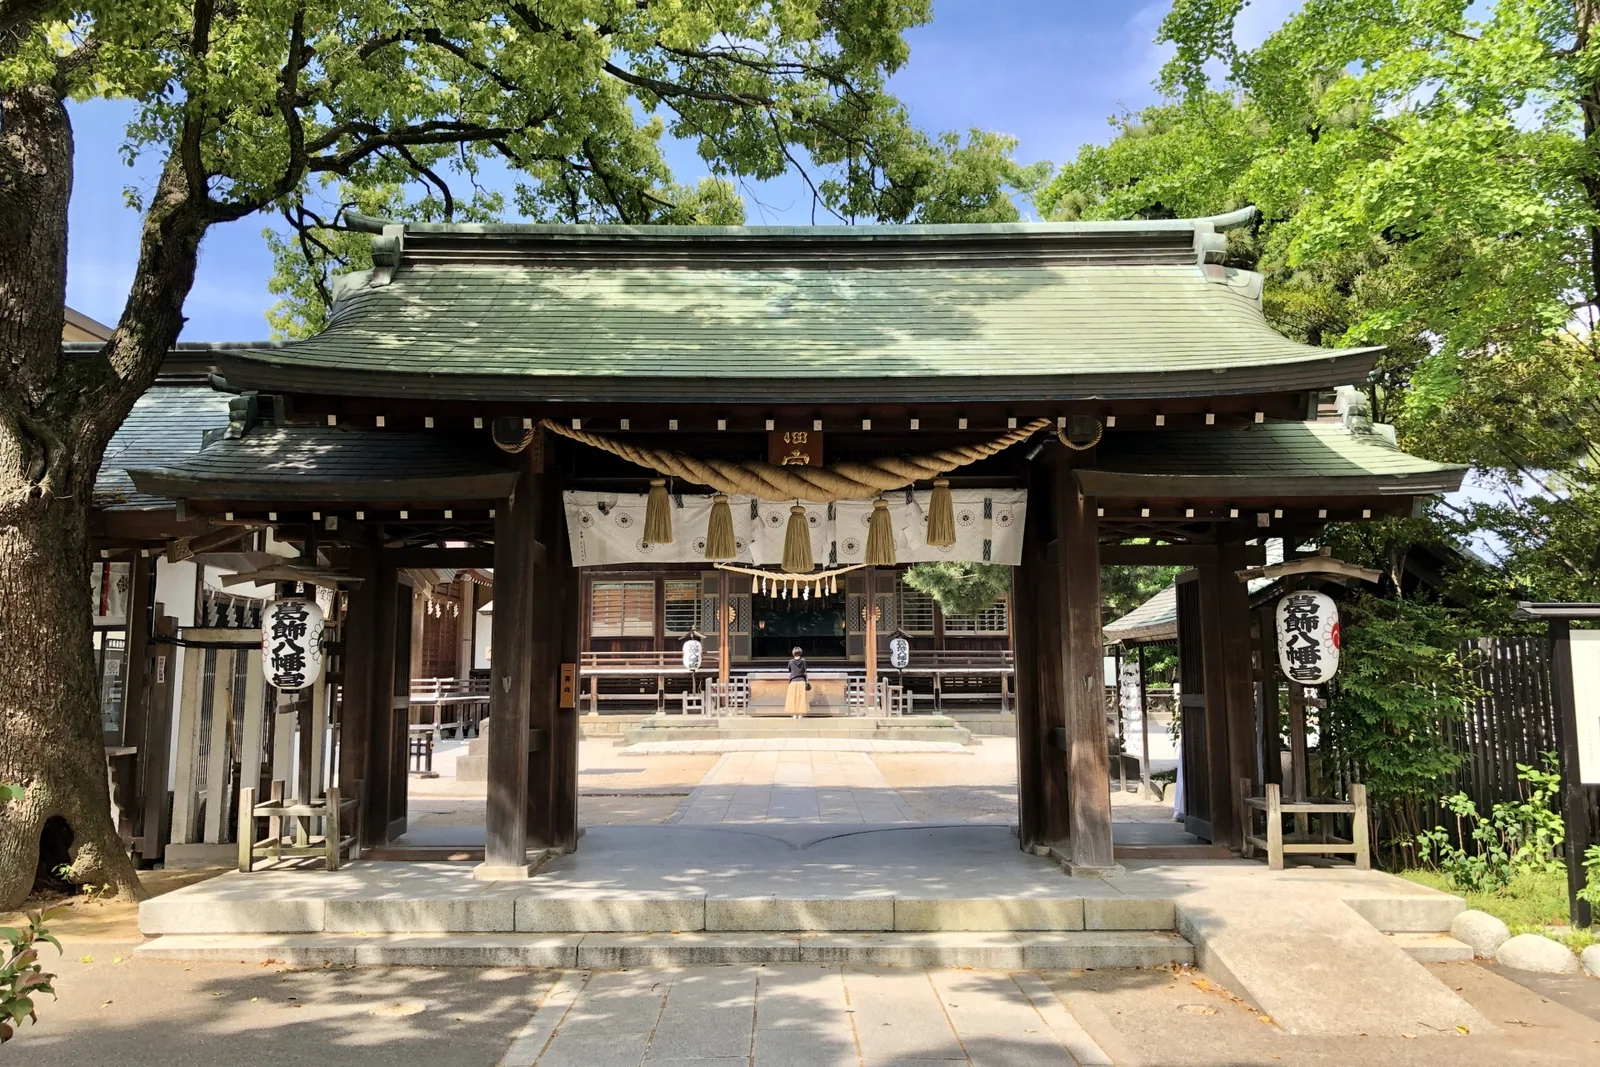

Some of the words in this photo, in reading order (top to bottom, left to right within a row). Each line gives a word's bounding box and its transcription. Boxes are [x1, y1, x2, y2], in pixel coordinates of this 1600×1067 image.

[270, 601, 310, 688] 葛飾八幡宮
[1283, 594, 1322, 681] 葛飾八幡宮
